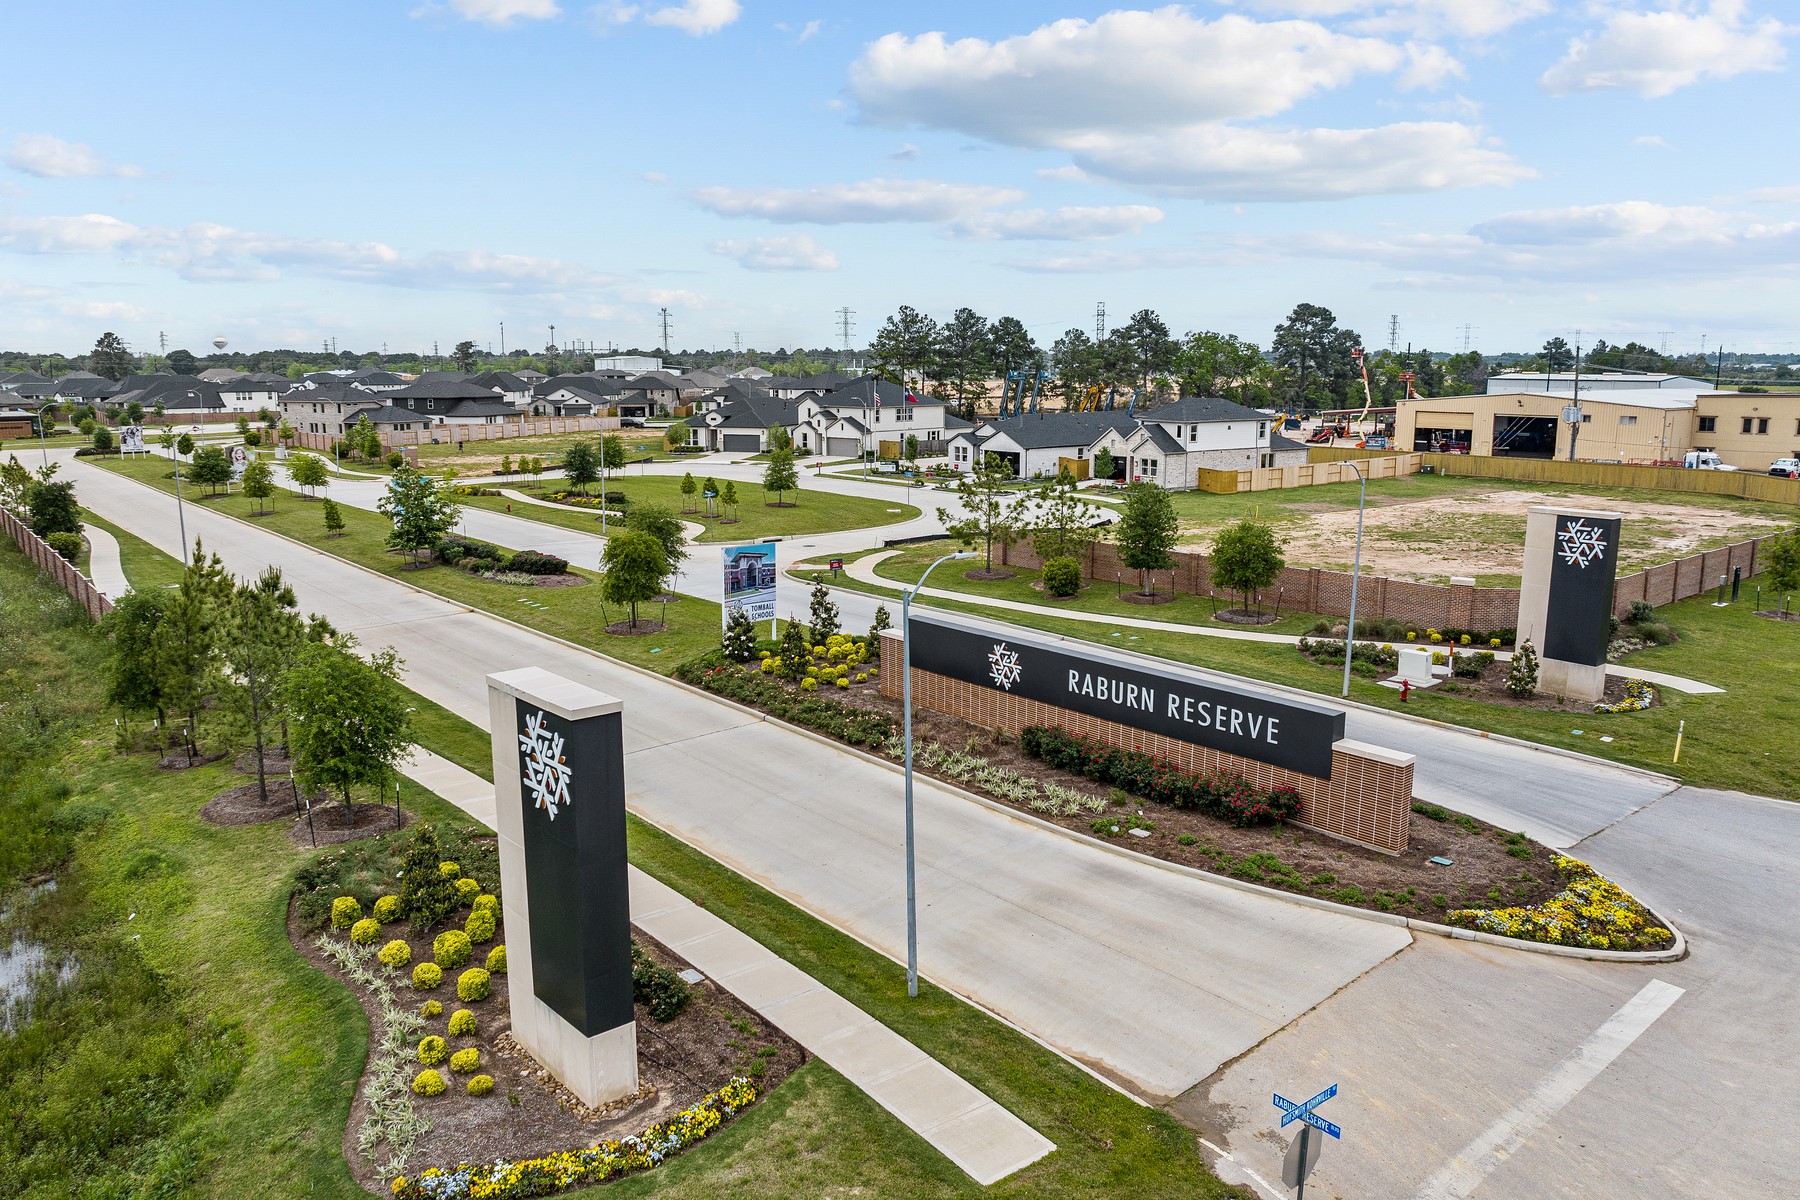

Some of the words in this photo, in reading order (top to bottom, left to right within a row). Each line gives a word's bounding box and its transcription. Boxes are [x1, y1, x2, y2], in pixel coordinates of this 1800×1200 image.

[751, 603, 774, 612] TOMBALL
[751, 610, 774, 620] SCHOOLS
[1068, 669, 1155, 713] RABURN
[1167, 693, 1280, 745] RESERVE
[1274, 1095, 1298, 1112] RABUR
